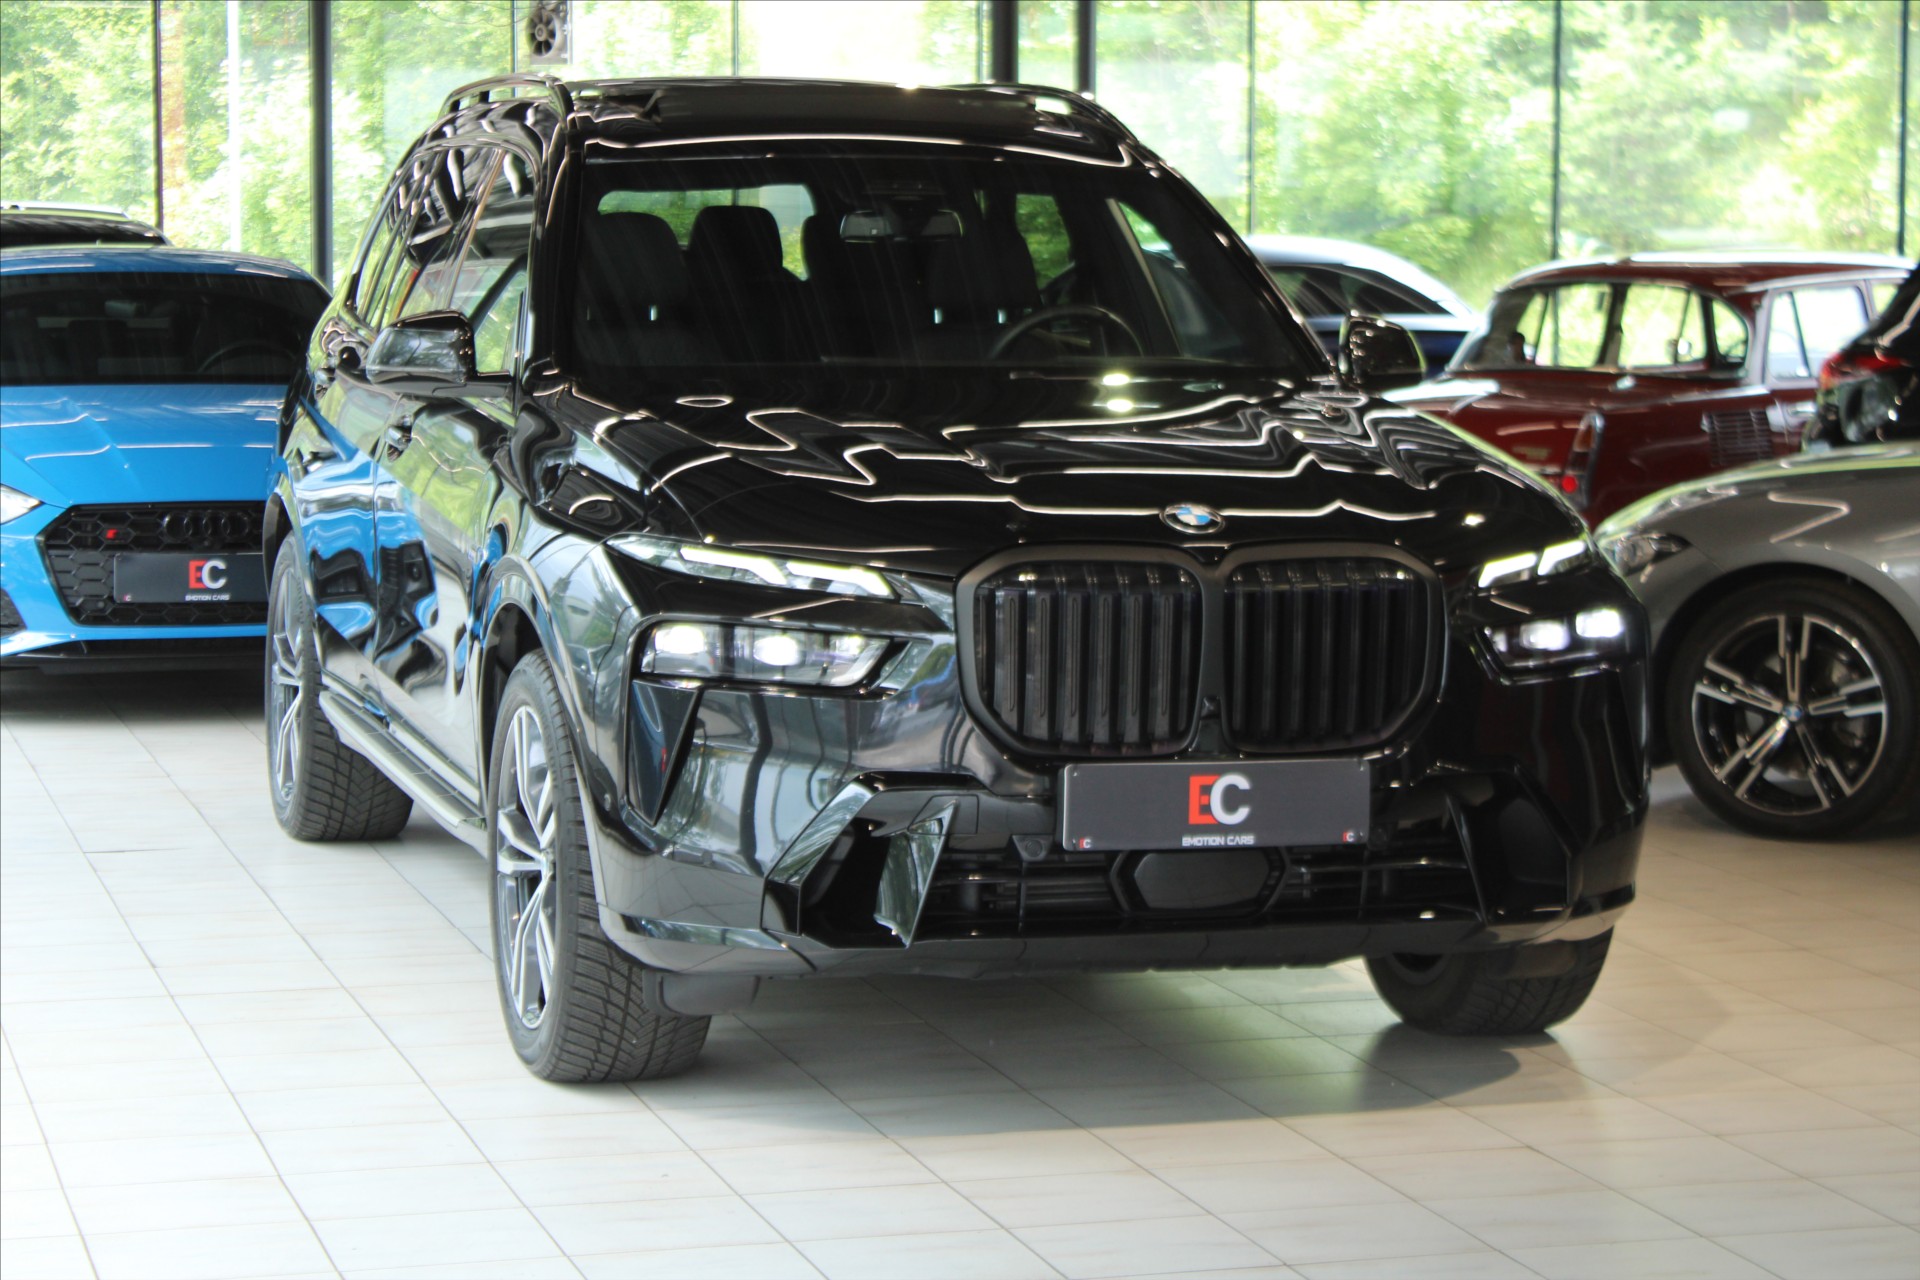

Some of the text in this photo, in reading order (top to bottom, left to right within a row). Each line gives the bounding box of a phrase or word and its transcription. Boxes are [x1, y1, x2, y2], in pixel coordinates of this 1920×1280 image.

[188, 559, 227, 590] EC
[1188, 773, 1251, 825] EC
[1181, 834, 1255, 847] EMOTION CARS
